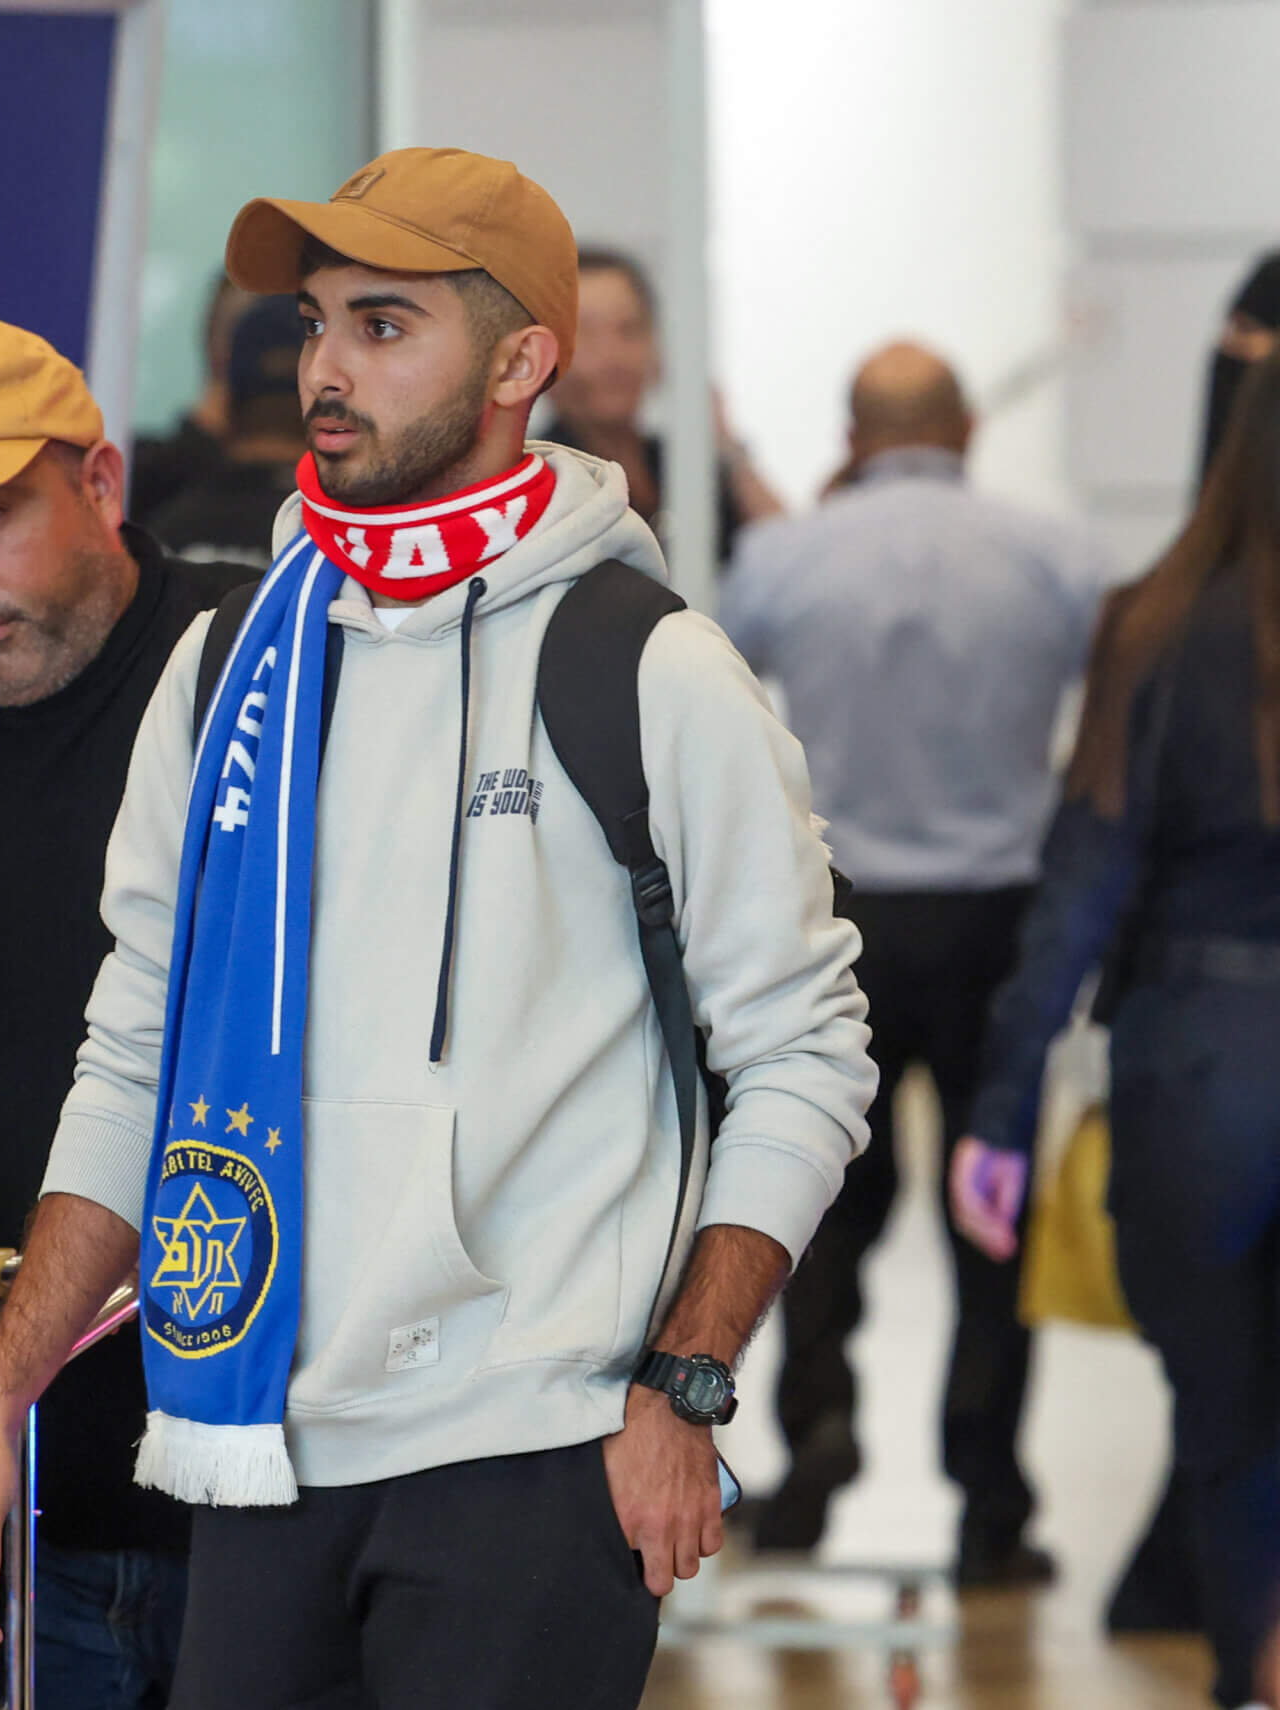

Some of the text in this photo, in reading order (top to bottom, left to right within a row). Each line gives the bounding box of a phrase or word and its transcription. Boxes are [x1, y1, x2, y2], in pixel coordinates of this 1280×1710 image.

[476, 770, 500, 793] THE
[465, 794, 488, 818] IS
[186, 1150, 214, 1172] TEL
[196, 1324, 232, 1344] 1906
